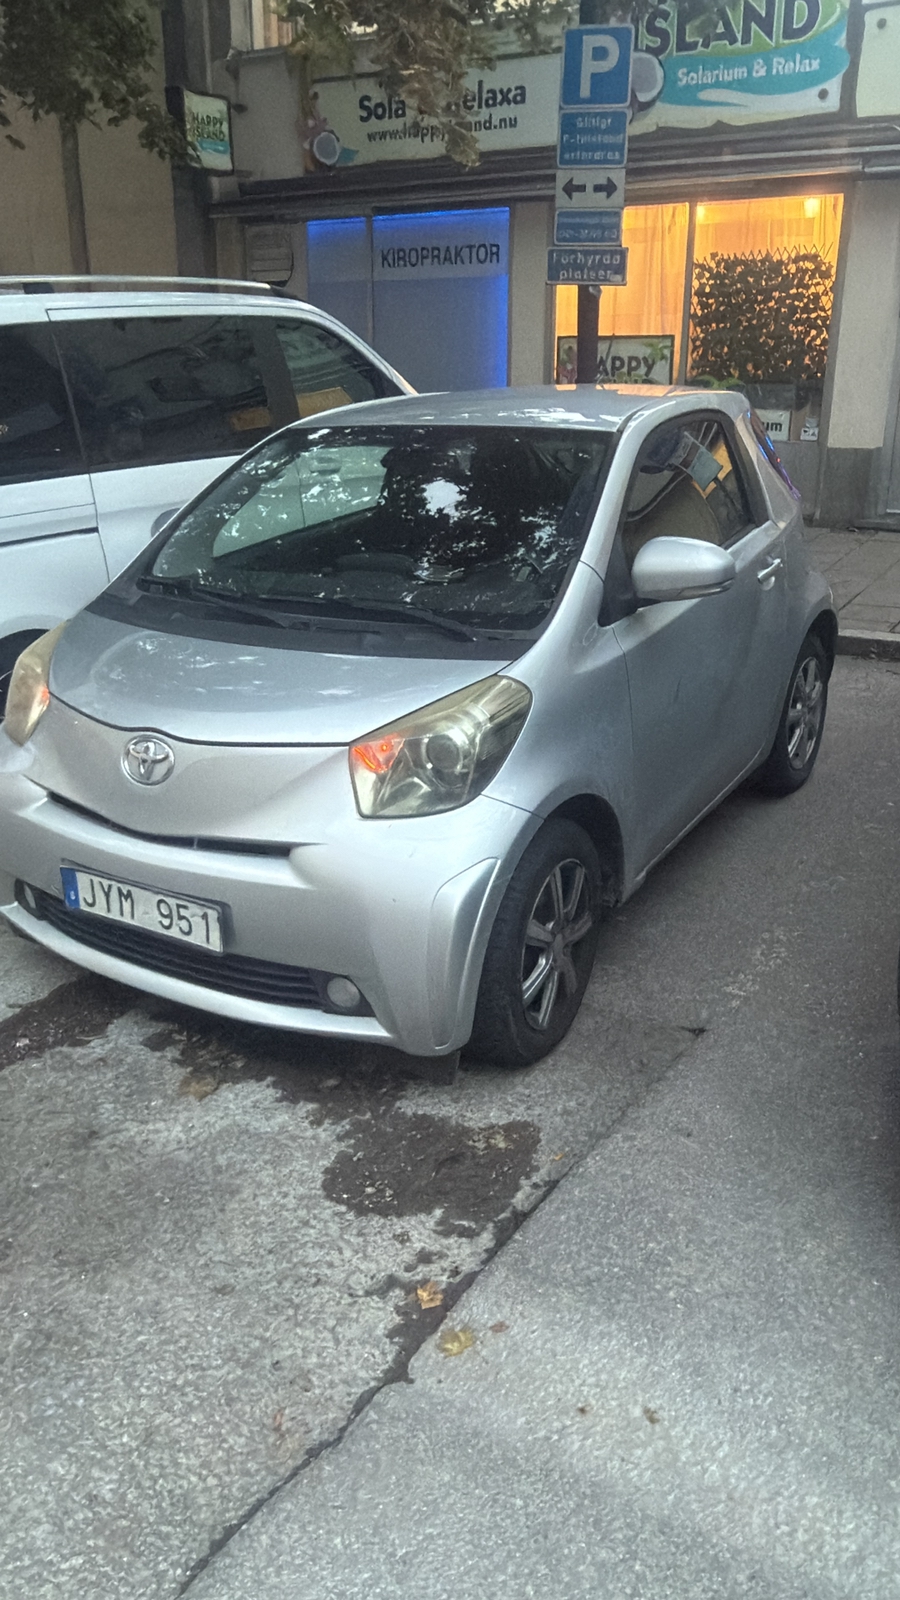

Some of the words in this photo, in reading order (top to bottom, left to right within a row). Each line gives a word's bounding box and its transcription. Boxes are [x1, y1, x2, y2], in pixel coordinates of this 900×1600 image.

[580, 34, 620, 99] P
[677, 66, 748, 87] Solarium
[753, 59, 767, 78] &
[772, 53, 821, 75] Relax
[192, 111, 225, 129] HAPPY
[380, 243, 501, 269] KIROPRAKTOR
[597, 355, 656, 378] APPY
[82, 878, 135, 921] JYM
[156, 898, 211, 944] 951
